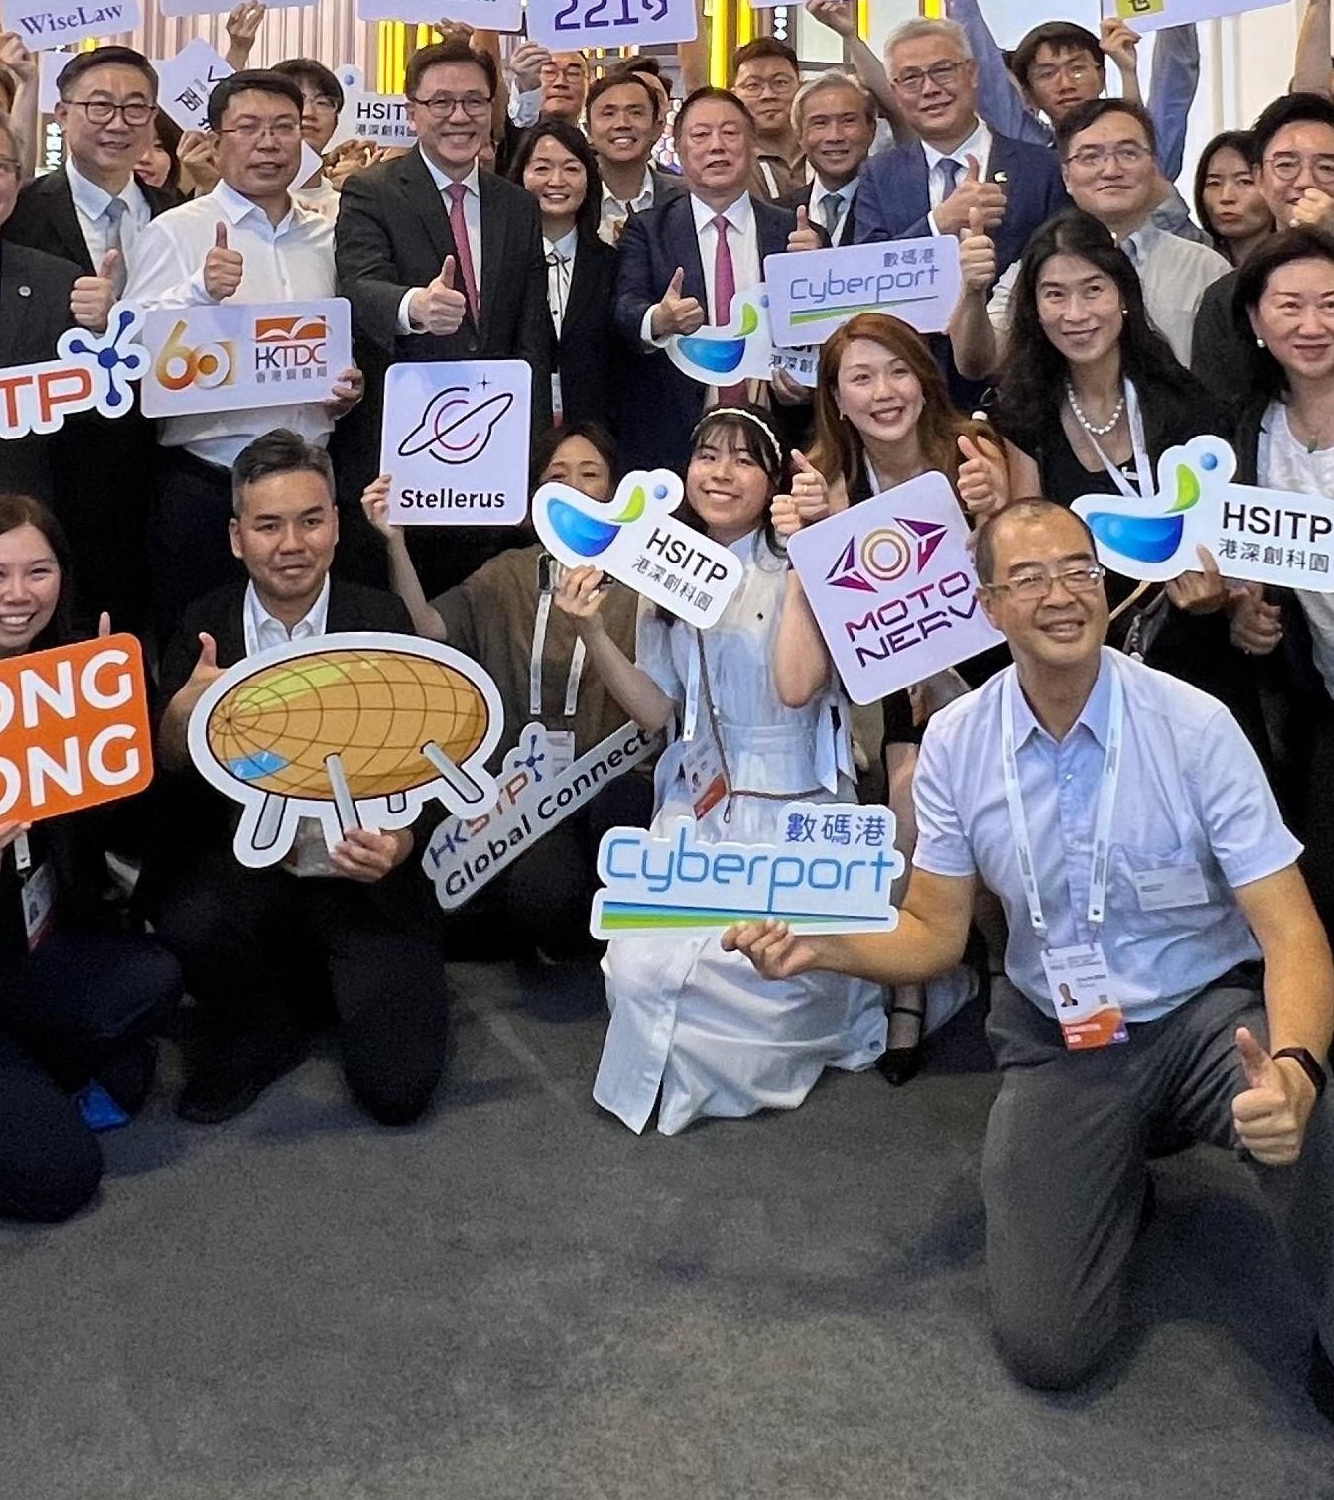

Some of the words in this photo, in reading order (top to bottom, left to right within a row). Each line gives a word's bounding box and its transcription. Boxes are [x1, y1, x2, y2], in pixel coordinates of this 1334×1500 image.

[18, 3, 124, 37] WiseLaw
[357, 102, 405, 120] HSIT
[883, 248, 936, 269] 數碼港
[790, 264, 940, 304] Cyberport
[255, 343, 328, 371] HKTDC
[399, 486, 506, 511] Stellerus
[1222, 501, 1333, 544] HSITP
[645, 526, 730, 586] HSITP
[1217, 537, 1331, 574] 港深創科園
[631, 553, 716, 613] 港深創科園
[844, 570, 971, 643] MOTO
[445, 813, 532, 896] Global
[536, 728, 651, 820] Connect
[784, 811, 887, 848] 數碼港
[605, 833, 897, 912] Cyberport
